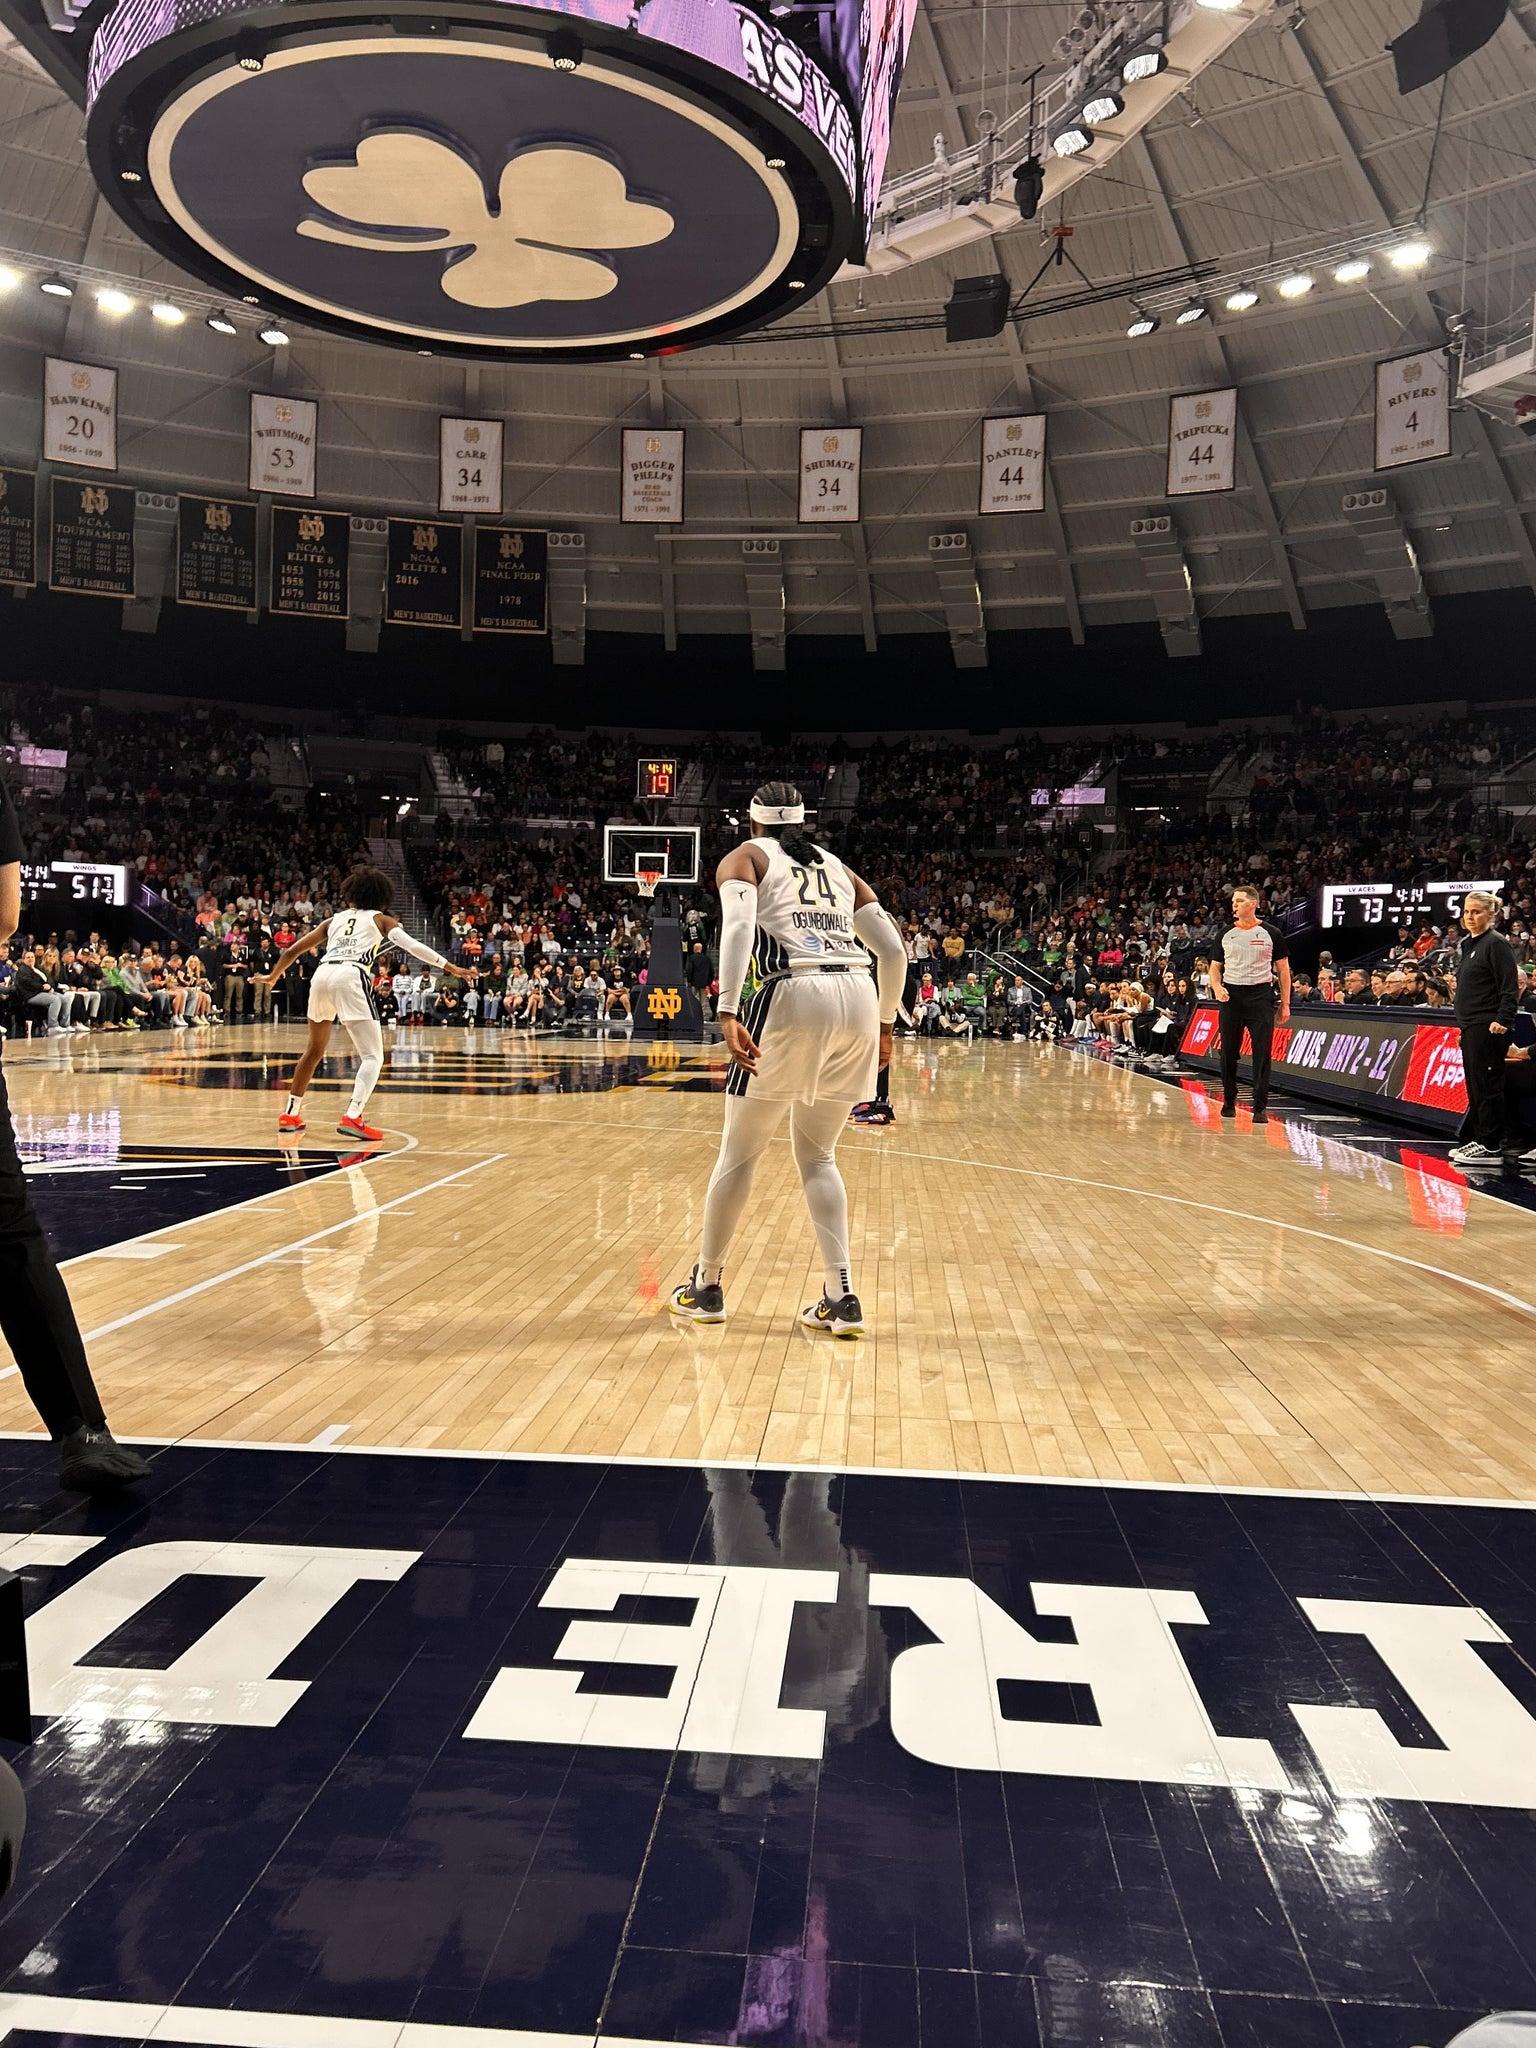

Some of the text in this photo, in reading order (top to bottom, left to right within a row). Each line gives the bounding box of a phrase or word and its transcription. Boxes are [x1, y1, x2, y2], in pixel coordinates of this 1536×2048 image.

[1388, 387, 1438, 407] RIVERS
[49, 396, 111, 415] HAWKINS
[66, 416, 94, 439] 20
[1405, 411, 1419, 432] 4
[256, 429, 311, 446] WHITMORE
[1175, 425, 1229, 441] TRIPUCKA
[271, 448, 294, 468] 53
[456, 450, 487, 460] CARR
[986, 448, 1041, 463] DANTLEY
[1188, 444, 1214, 465] 44
[631, 460, 676, 471] DIGGER
[805, 460, 856, 473] SHUMATE
[458, 468, 482, 486] 34
[634, 471, 673, 482] PHELPS
[1000, 466, 1024, 486] 44
[818, 478, 840, 496] 34
[78, 516, 111, 528] NCAA
[56, 524, 130, 540] TOURNAMENT
[203, 532, 234, 544] NCAA
[191, 541, 245, 556] SWEET 16
[295, 542, 326, 554] NCAA
[287, 552, 334, 564] ELITE 8
[410, 553, 440, 564] NCAA
[281, 564, 340, 579] 1953 1954
[402, 562, 447, 574] ELITE 8
[497, 562, 525, 570] NCAA
[396, 574, 419, 585] 2016
[480, 570, 541, 581] FINAL FOUR
[59, 576, 127, 591] MEN'S BASKETBALL
[281, 576, 340, 590] 1958 1978
[185, 590, 248, 604] MEN'S BASKETBALL
[280, 588, 340, 601] 1979 2015
[499, 595, 521, 605] 1978
[278, 600, 340, 613] MEN'S BASKETBALL
[394, 610, 454, 623] MEN'S BASKETBALL
[481, 617, 538, 628] MEN'S BASKETBALL
[648, 764, 672, 774] 4:14
[652, 775, 669, 793] 19
[72, 875, 99, 898] 51
[790, 866, 838, 908] 24
[31, 890, 37, 900] 3
[105, 893, 112, 904] 2
[1396, 888, 1423, 903] 4:14
[1360, 898, 1383, 923] 73
[344, 918, 356, 936] 3
[792, 911, 849, 933] OGUNBOWALE
[1406, 915, 1412, 925] 3
[1194, 1030, 1209, 1044] APP
[1286, 1029, 1312, 1064] ON
[1302, 1031, 1327, 1068] US.
[1322, 1034, 1361, 1073] MAY
[1349, 1036, 1370, 1075] 2
[1368, 1039, 1398, 1080] 12
[1429, 1064, 1466, 1089] APP
